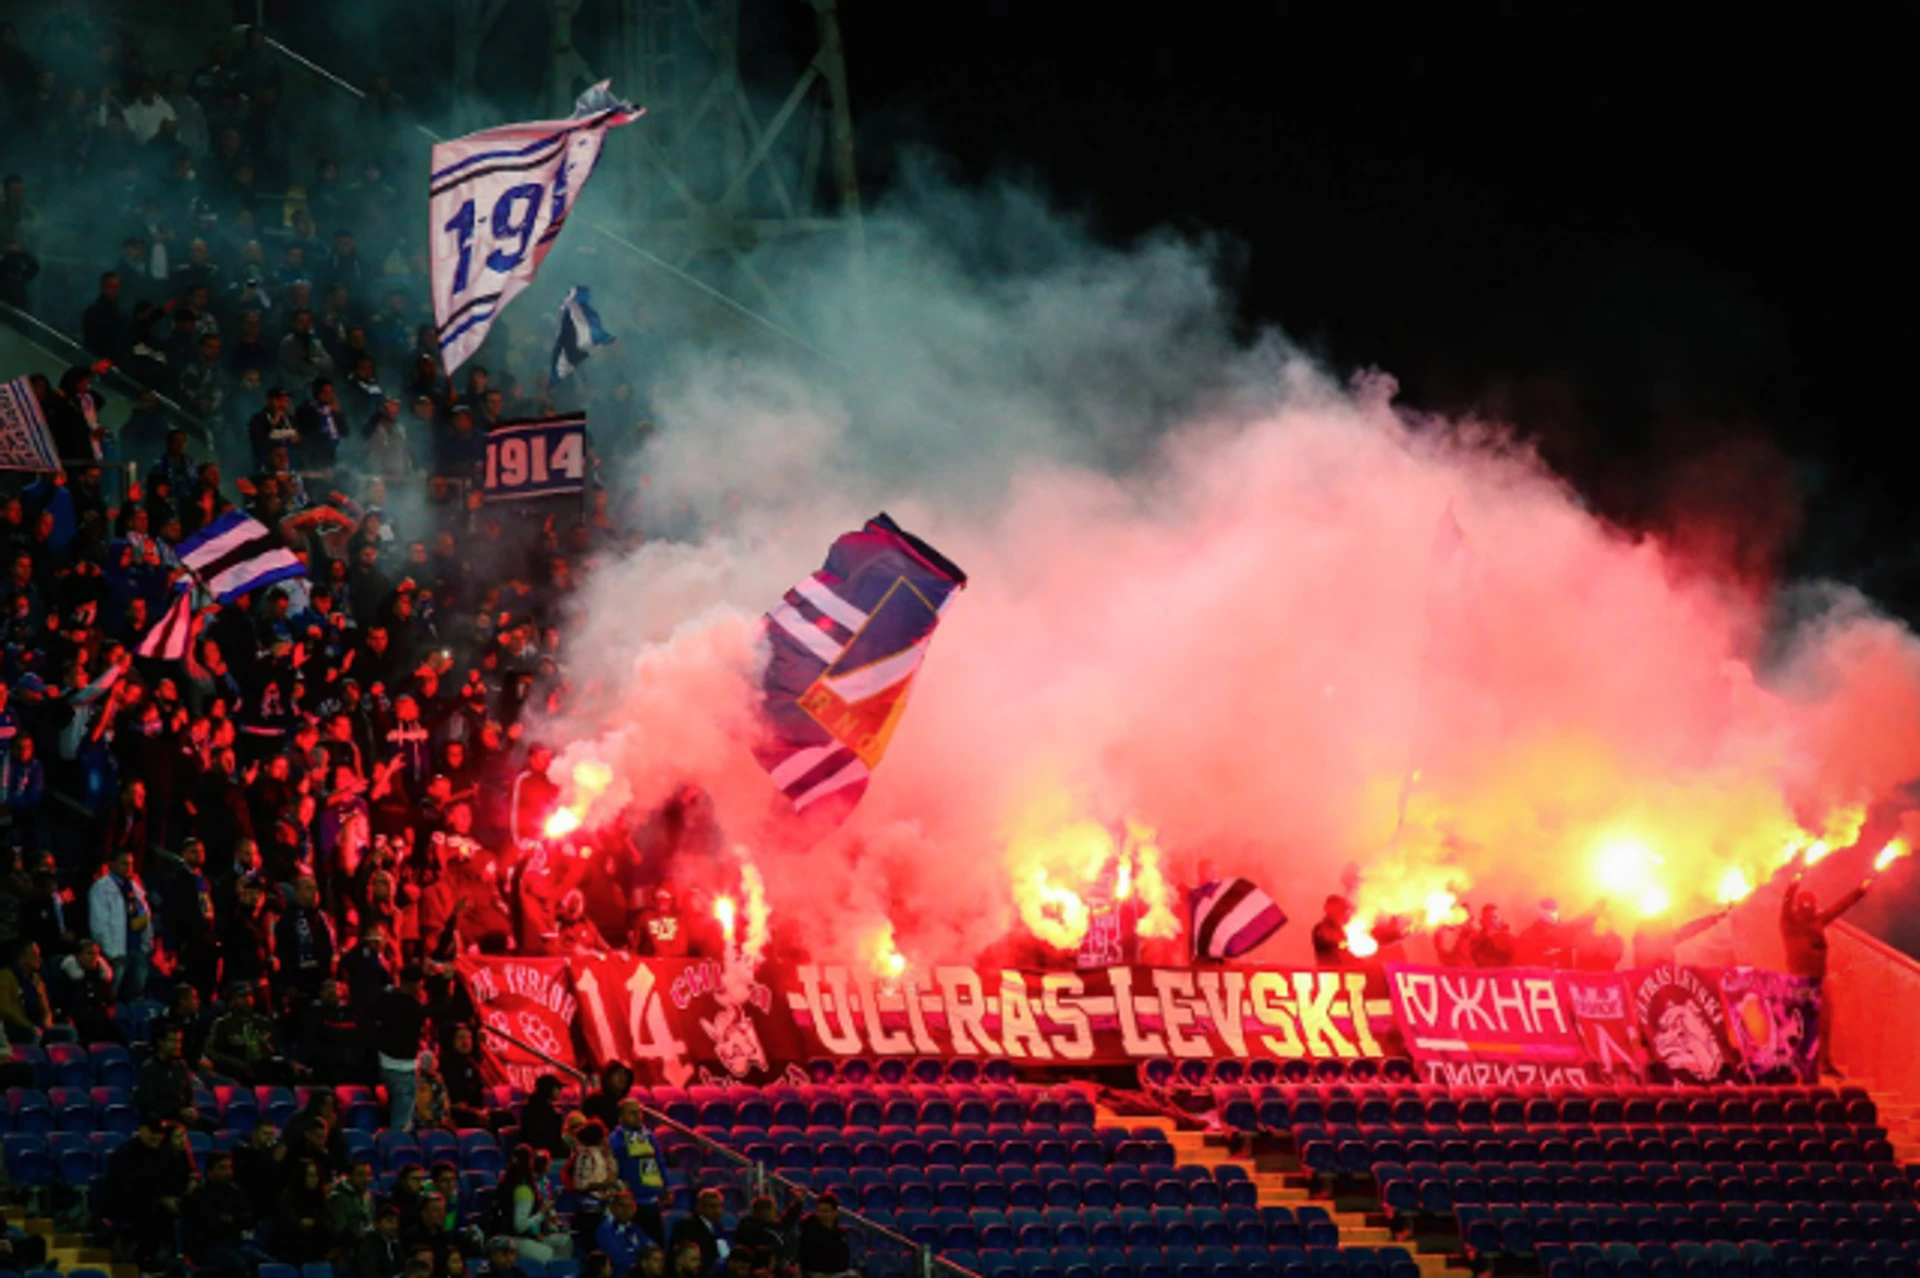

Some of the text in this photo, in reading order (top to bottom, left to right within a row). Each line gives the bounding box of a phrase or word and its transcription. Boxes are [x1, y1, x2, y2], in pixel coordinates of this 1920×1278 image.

[486, 432, 584, 488] 1914
[577, 962, 692, 1088] 14
[797, 965, 1380, 1059] ULTRAS LEVSKI
[1395, 972, 1568, 1034] ЮЖНА
